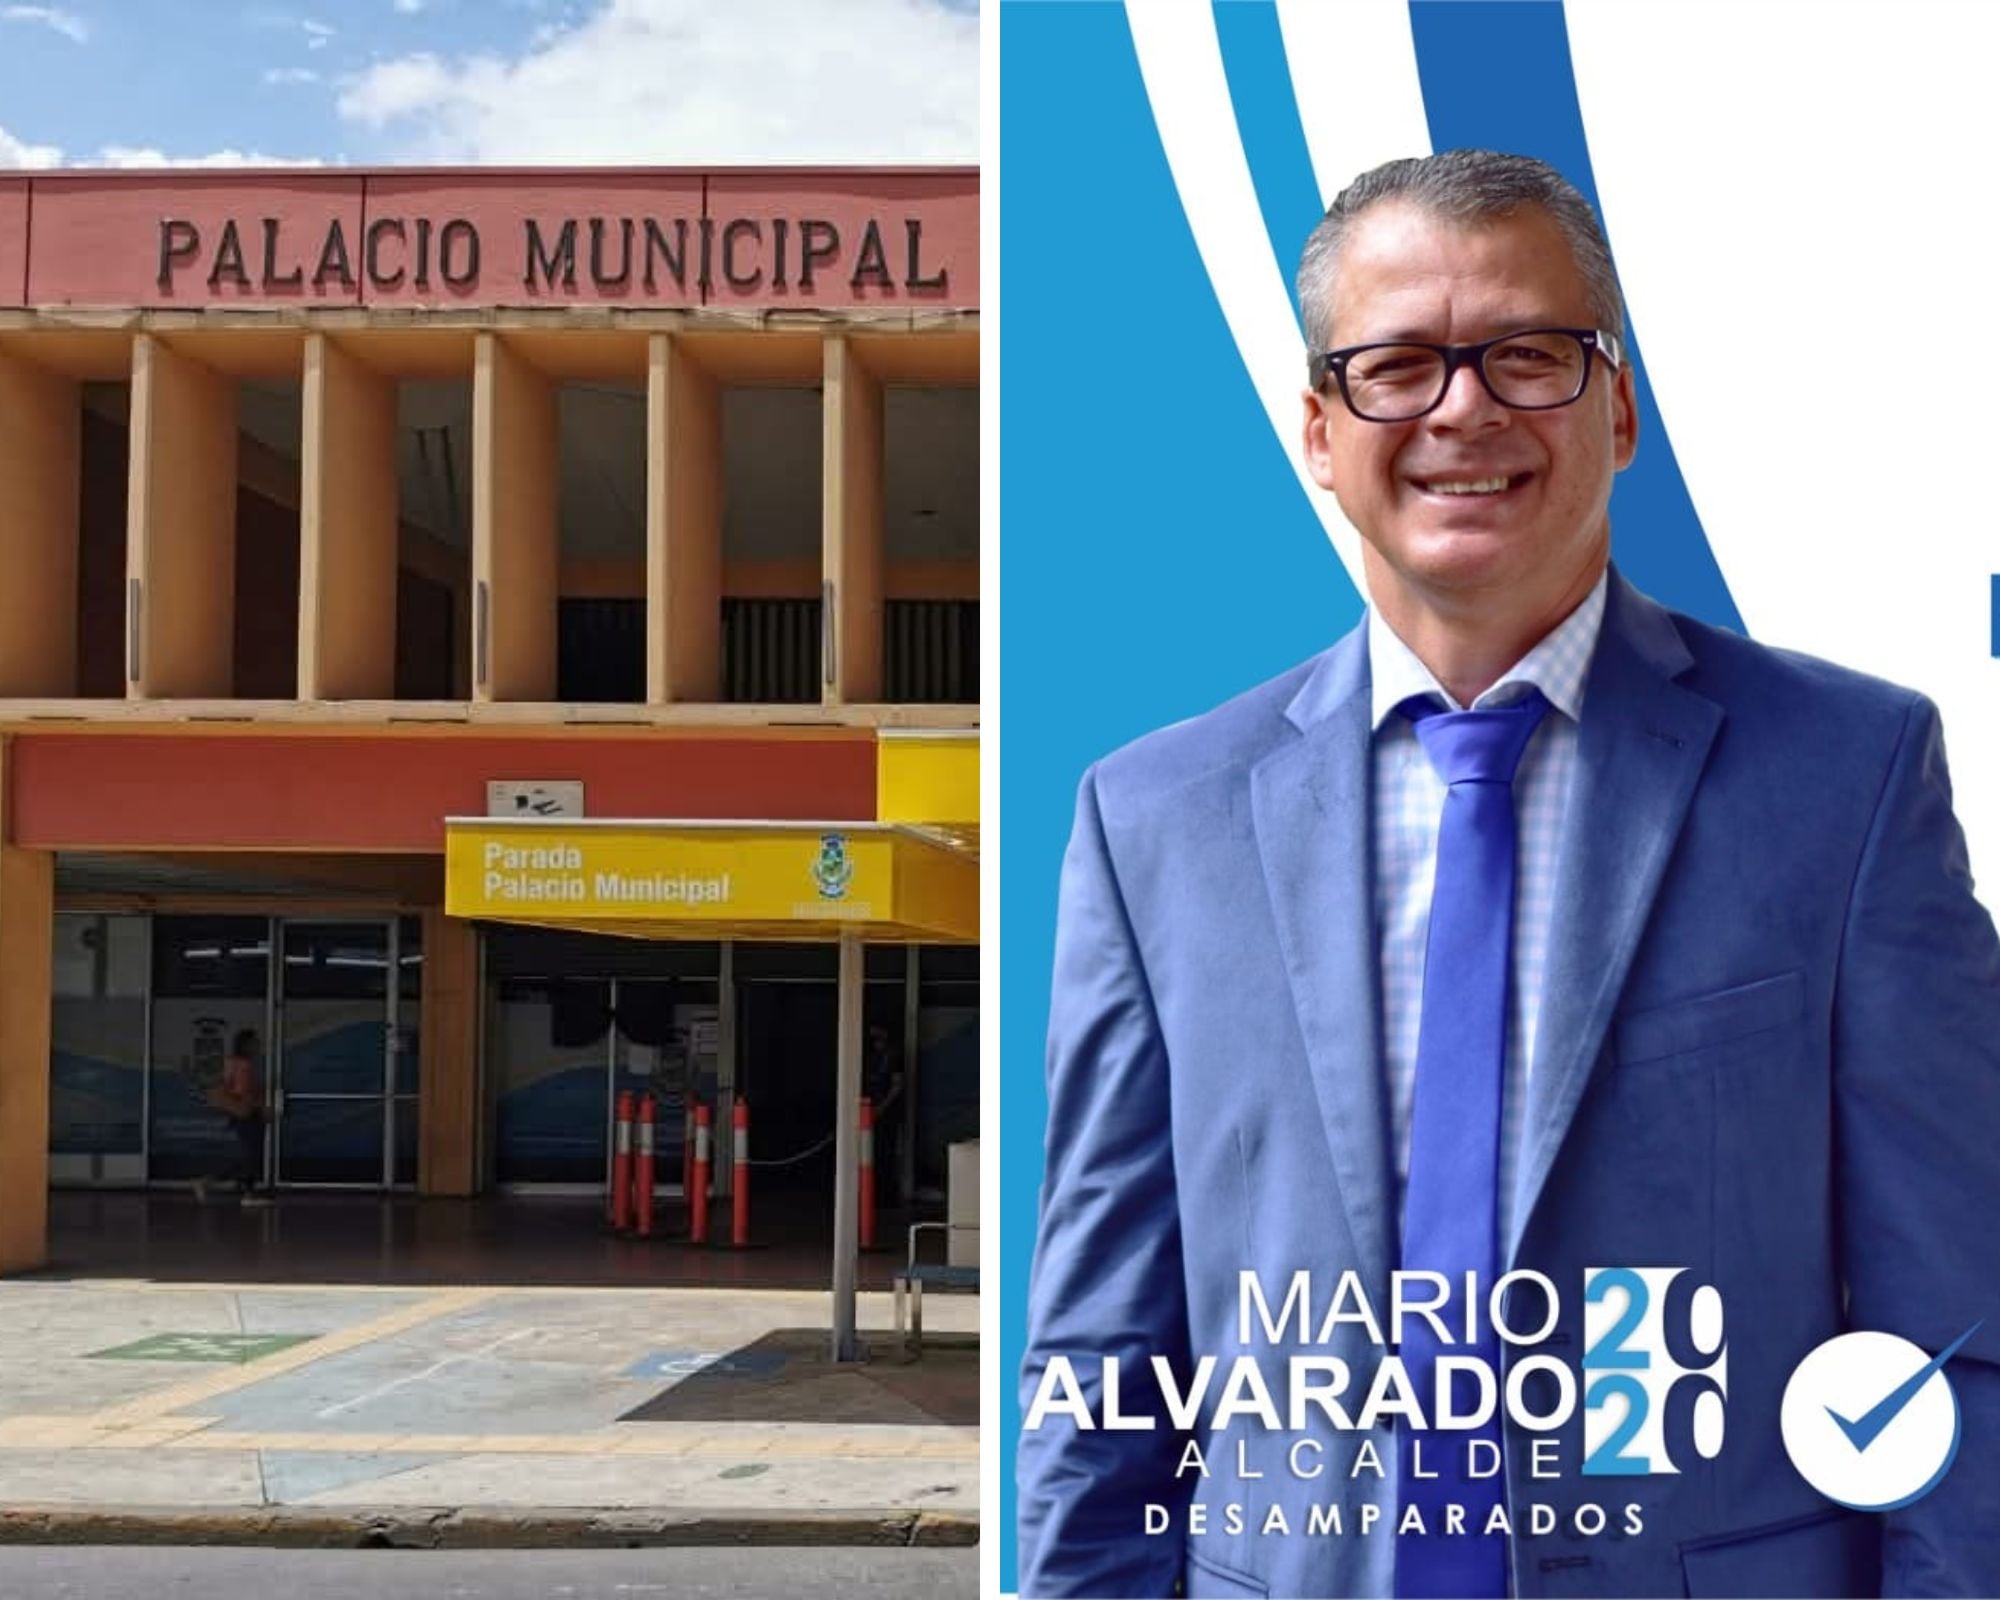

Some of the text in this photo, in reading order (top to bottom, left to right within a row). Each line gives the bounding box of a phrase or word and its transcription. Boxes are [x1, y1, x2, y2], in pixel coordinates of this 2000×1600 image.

[156, 217, 949, 290] PALACIO MUNICIPAL
[485, 841, 582, 869] Parada
[485, 872, 730, 907] Palacio Municipal
[1239, 1269, 1560, 1345] MARIO
[1022, 1355, 1577, 1431] ALVARADO
[1175, 1438, 1561, 1479] ALCALDE
[1144, 1503, 1644, 1536] DESAMPARADOS
